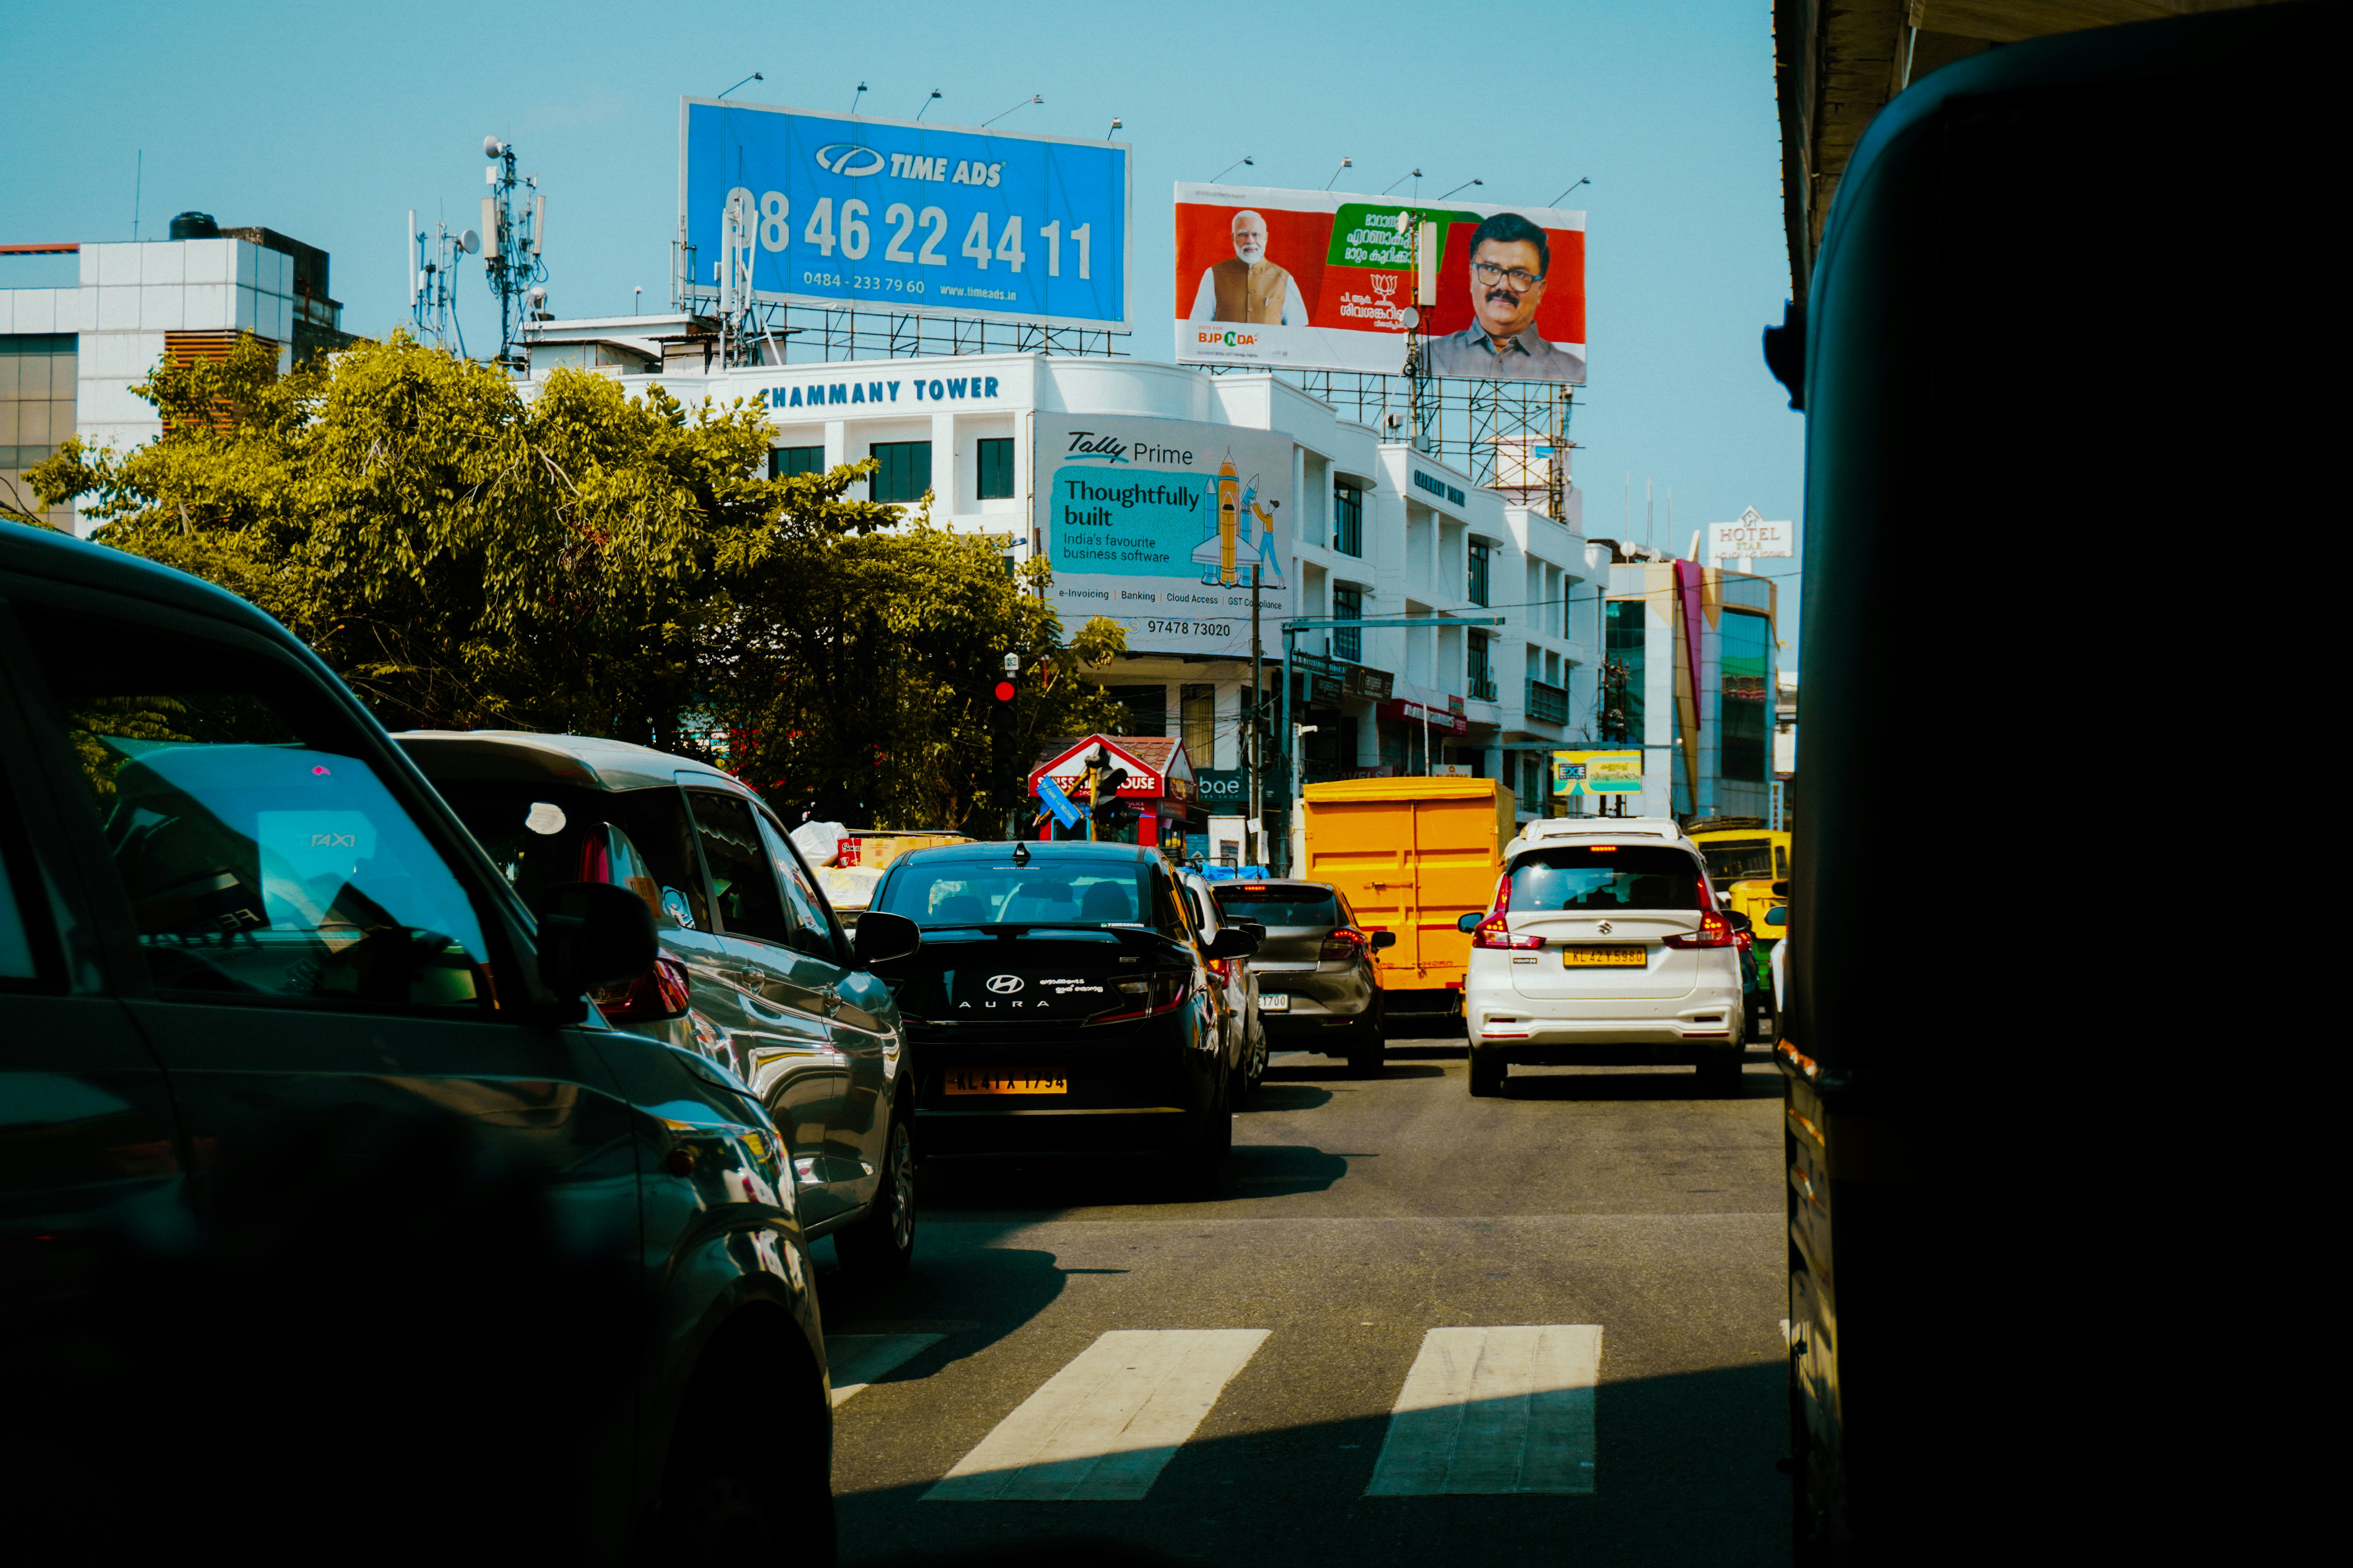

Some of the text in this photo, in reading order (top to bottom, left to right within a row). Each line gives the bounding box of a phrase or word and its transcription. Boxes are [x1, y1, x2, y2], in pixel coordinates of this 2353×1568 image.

[890, 153, 1001, 188] TIME ADS
[805, 197, 870, 259] 46
[885, 203, 947, 266] 22
[962, 212, 1026, 273] 44
[1041, 220, 1090, 279] 11
[804, 271, 841, 288] 0484
[853, 275, 880, 291] 233
[885, 277, 904, 292] 79
[907, 279, 925, 294] 60
[940, 284, 1016, 302] www.timeads.in
[1198, 332, 1222, 343] BJP
[760, 376, 999, 409] CHAMMANY TOWER
[1068, 431, 1193, 465] Tally Prime
[1064, 480, 1199, 511] Thoughtfully
[1065, 505, 1113, 526] built
[1064, 533, 1155, 548] India's favourite
[1720, 527, 1780, 541] HOTEL
[1064, 547, 1169, 563] business software
[1737, 542, 1762, 550] STAR
[1059, 589, 1281, 609] e-Invoicing Banking Cloud Access GST Copliance
[1148, 620, 1230, 636] 97478 73020
[1559, 767, 1585, 776] EDGE
[1037, 777, 1075, 789] SISS
[1117, 777, 1155, 789] OUSE
[1200, 776, 1239, 794] bae
[1573, 951, 1585, 961] KL
[958, 1071, 977, 1090] KL
[982, 1071, 1000, 1090] 41
[1006, 1071, 1015, 1089] X
[1024, 1071, 1064, 1089] 1794
